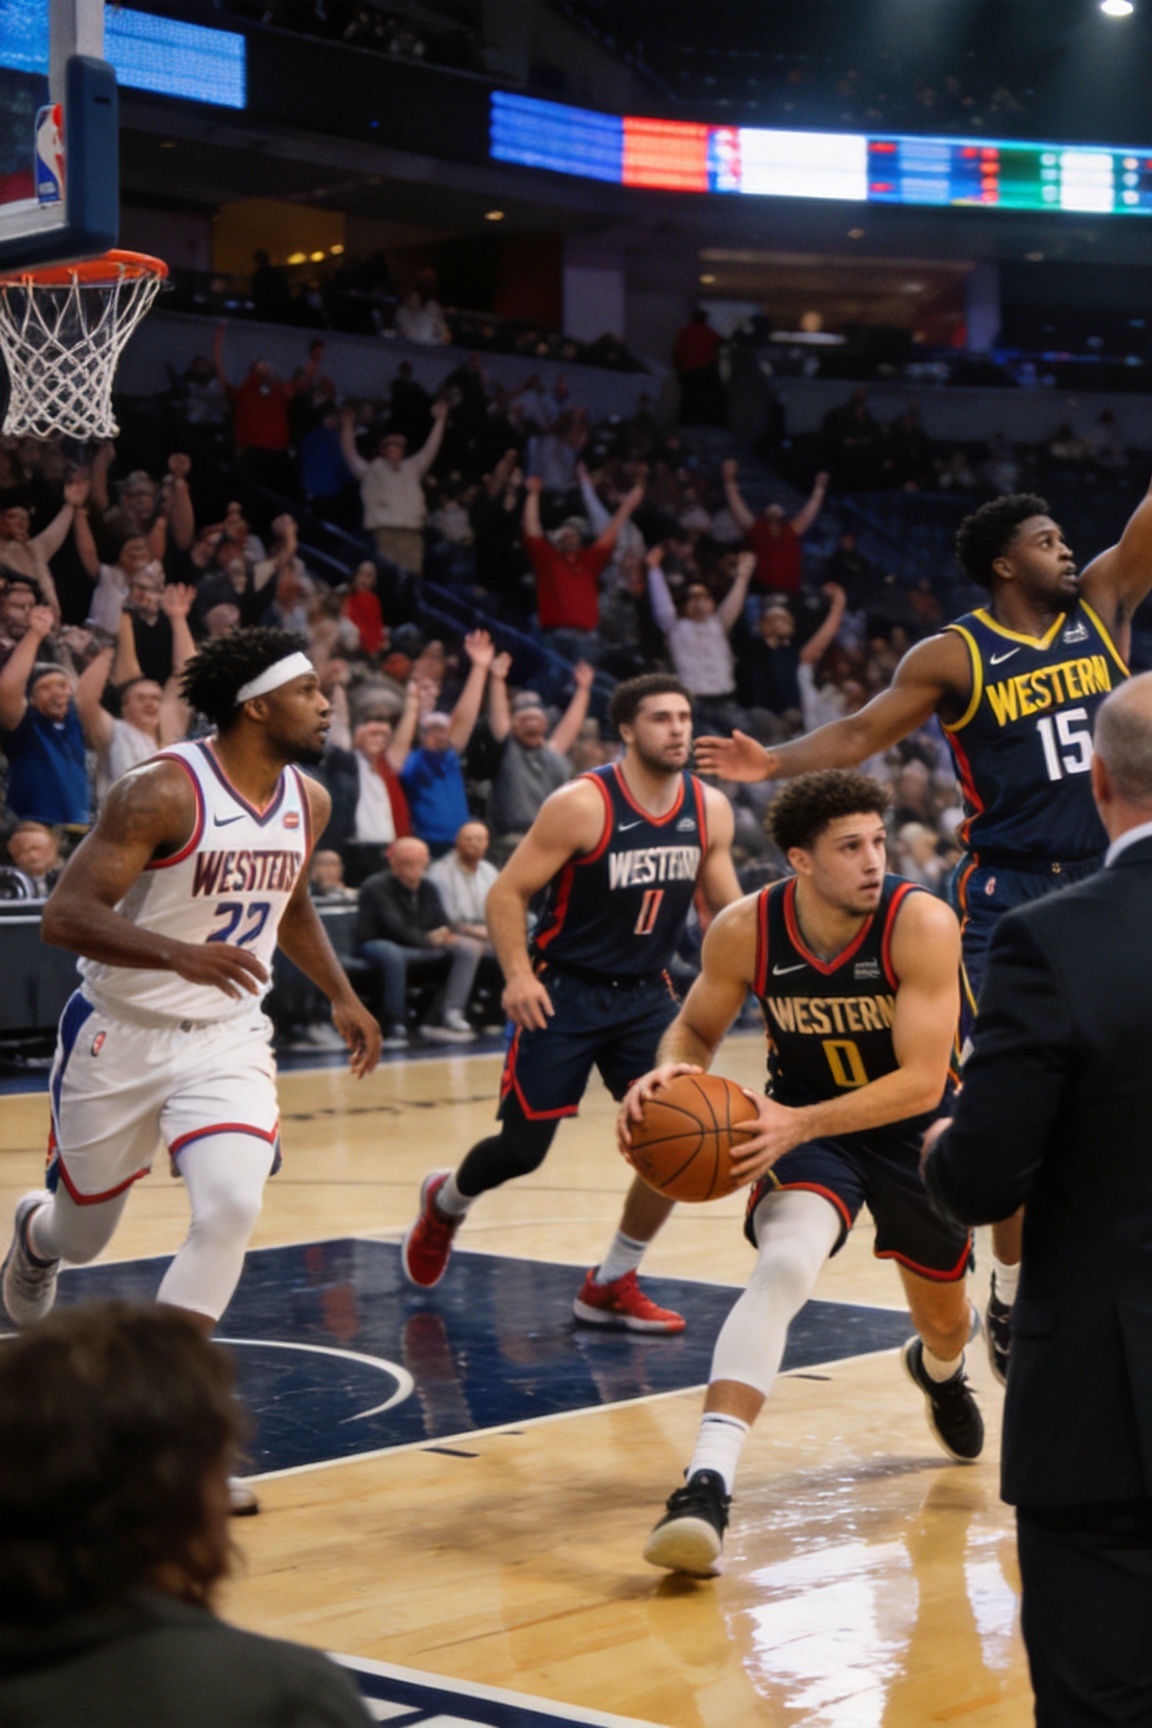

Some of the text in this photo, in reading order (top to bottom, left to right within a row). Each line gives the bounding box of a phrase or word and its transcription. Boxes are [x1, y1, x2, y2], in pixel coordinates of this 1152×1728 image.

[985, 655, 1112, 727] WESTERN
[1037, 707, 1093, 781] 15
[206, 902, 271, 945] 22
[766, 995, 896, 1035] WESTERN
[822, 1039, 869, 1087] 0
